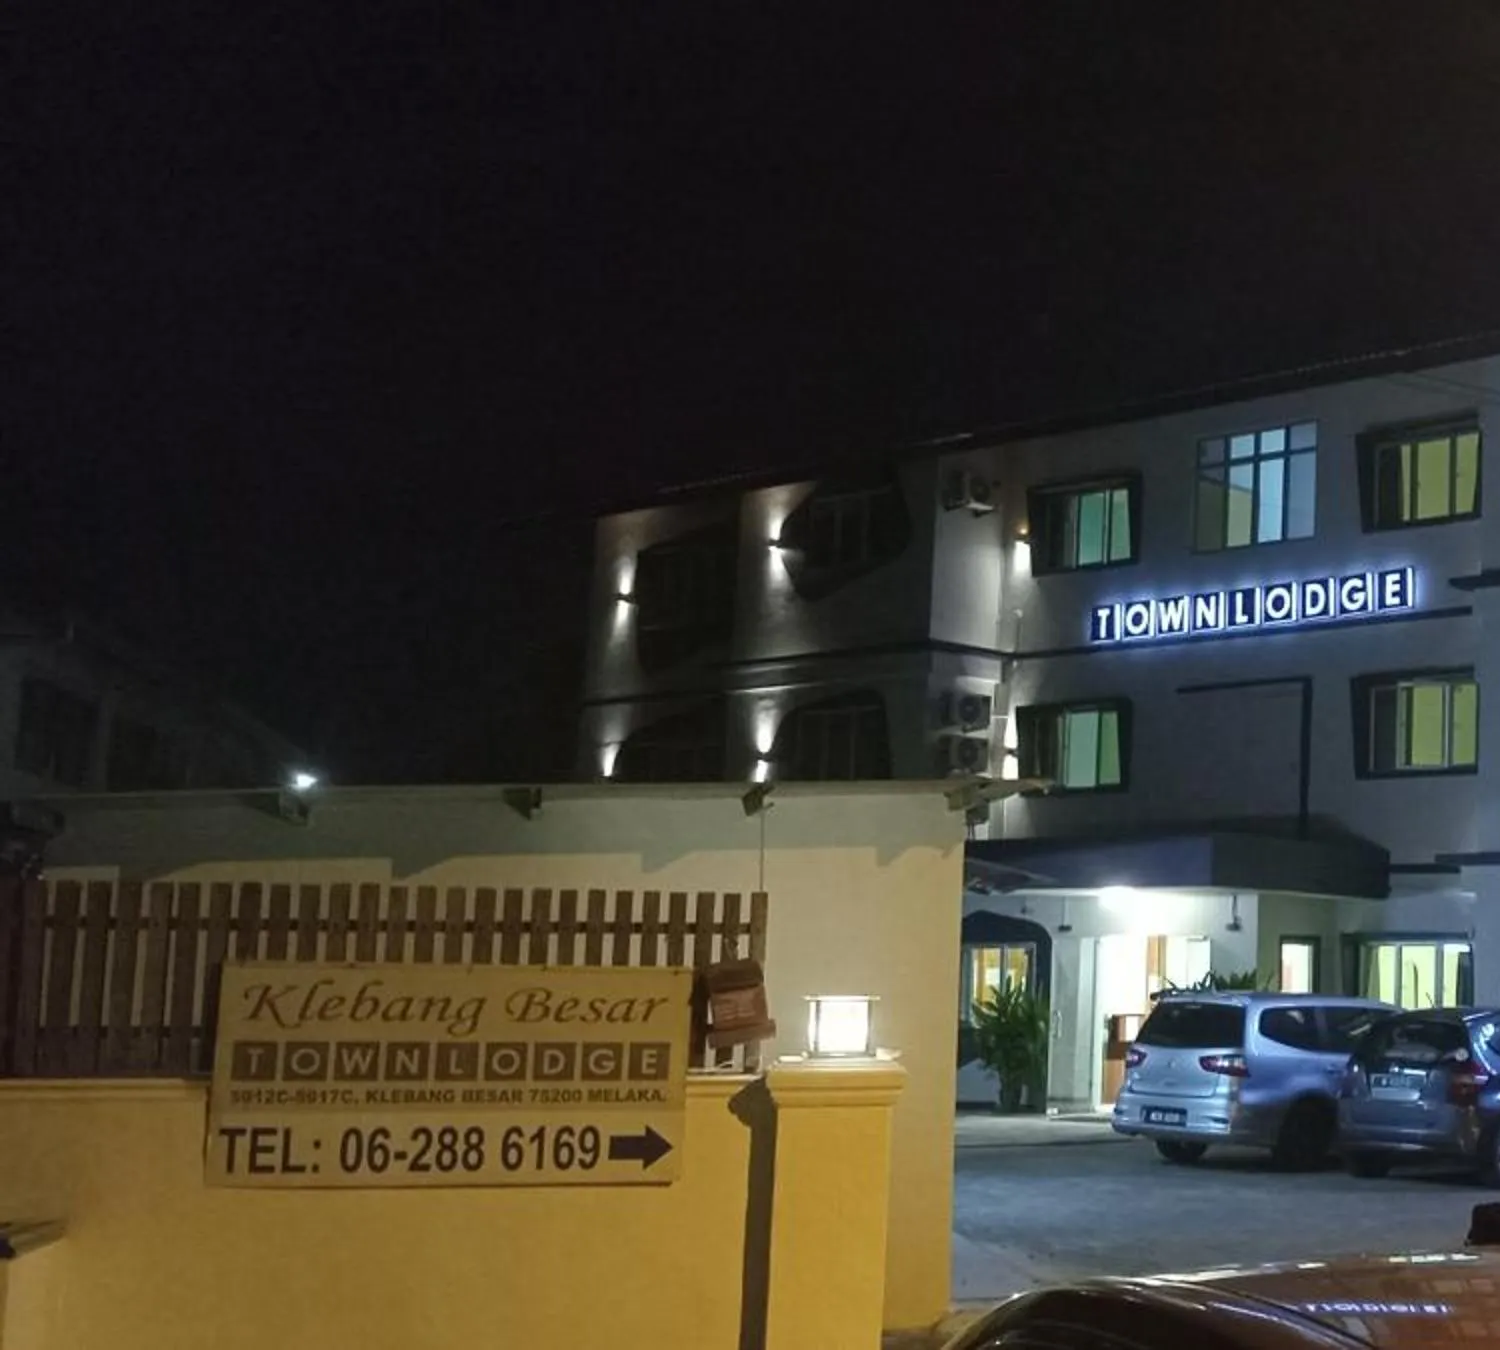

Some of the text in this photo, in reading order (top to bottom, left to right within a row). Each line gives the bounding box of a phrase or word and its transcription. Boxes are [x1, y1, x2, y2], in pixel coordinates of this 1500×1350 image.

[1095, 571, 1404, 639] TOWNLODGE
[241, 978, 488, 1036] Klebang
[504, 986, 670, 1025] Besar
[243, 1044, 662, 1078] TOWNLODGE
[365, 1088, 456, 1104] KLEBANG
[461, 1088, 523, 1104] BESAR
[528, 1088, 582, 1104] 75200
[218, 1125, 602, 1174] TEL: 06-288 6169
